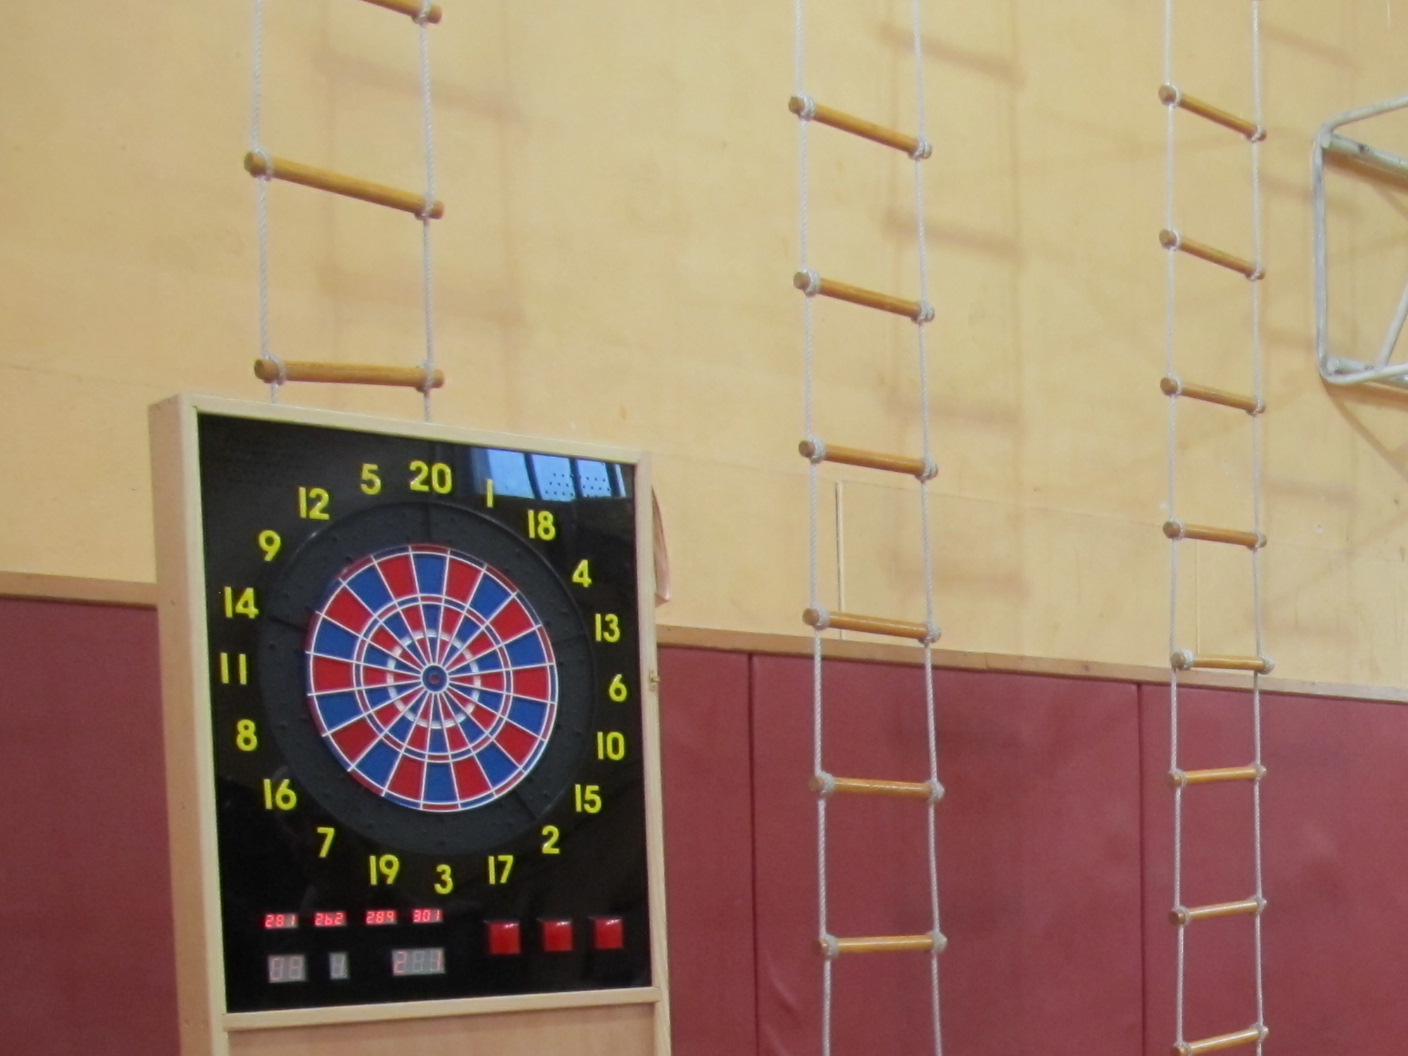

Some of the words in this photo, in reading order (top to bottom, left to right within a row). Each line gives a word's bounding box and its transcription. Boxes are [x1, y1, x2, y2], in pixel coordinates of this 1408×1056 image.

[360, 463, 383, 496] 5
[409, 460, 453, 495] 20
[298, 486, 331, 521] 12
[485, 479, 495, 508] 1
[527, 510, 557, 541] 18
[258, 530, 282, 562] 9
[572, 559, 593, 588] 4
[223, 586, 259, 619] 14
[594, 613, 621, 643] 13
[220, 652, 248, 685] 11
[608, 674, 628, 702] 6
[236, 719, 259, 752] 8
[597, 731, 626, 760] 10
[263, 780, 298, 811] 16
[575, 784, 603, 814] 15
[316, 827, 336, 858] 7
[541, 825, 561, 855] 2
[369, 854, 400, 886] 19
[433, 864, 454, 895] 3
[488, 855, 515, 885] 17
[413, 908, 441, 923] 301
